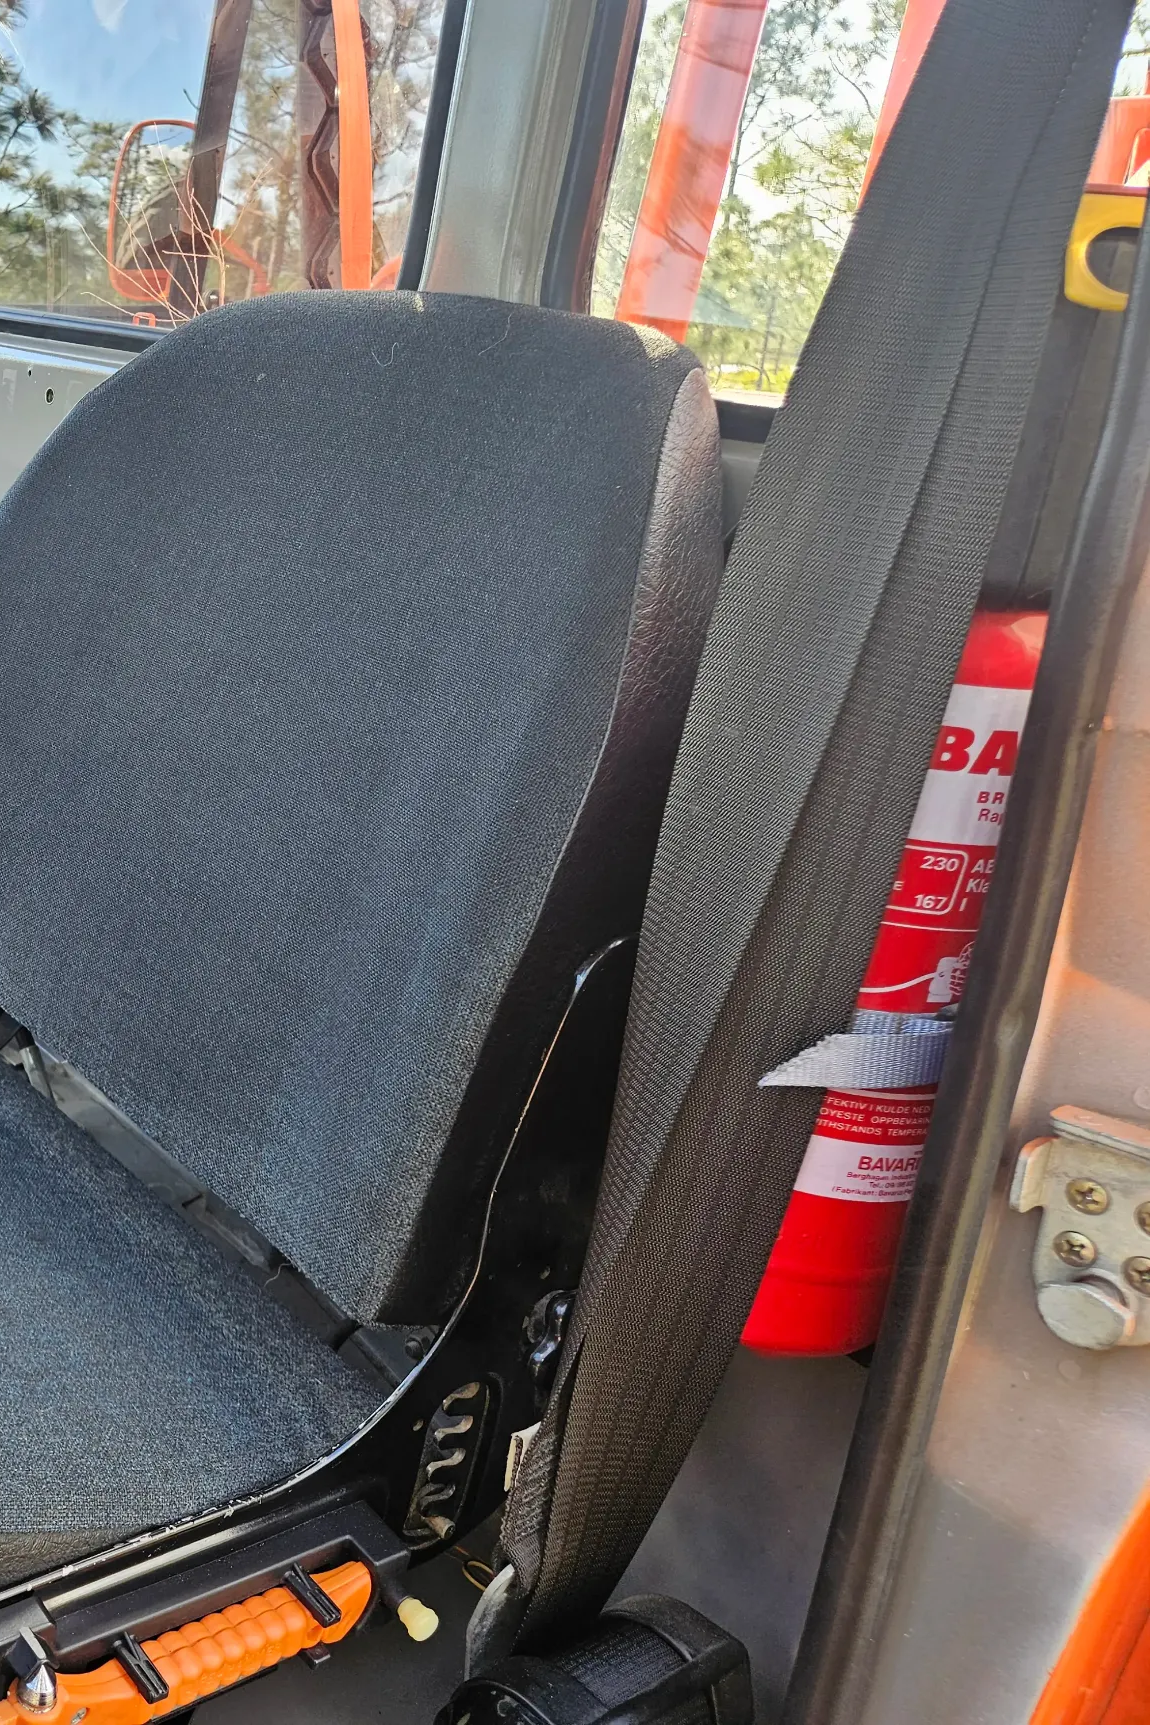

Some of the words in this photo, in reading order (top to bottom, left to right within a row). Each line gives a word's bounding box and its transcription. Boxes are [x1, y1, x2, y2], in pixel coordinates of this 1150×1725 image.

[977, 791, 1005, 804] BR
[920, 855, 959, 872] 230
[914, 894, 948, 910] 167
[875, 1103, 910, 1114] KULDE
